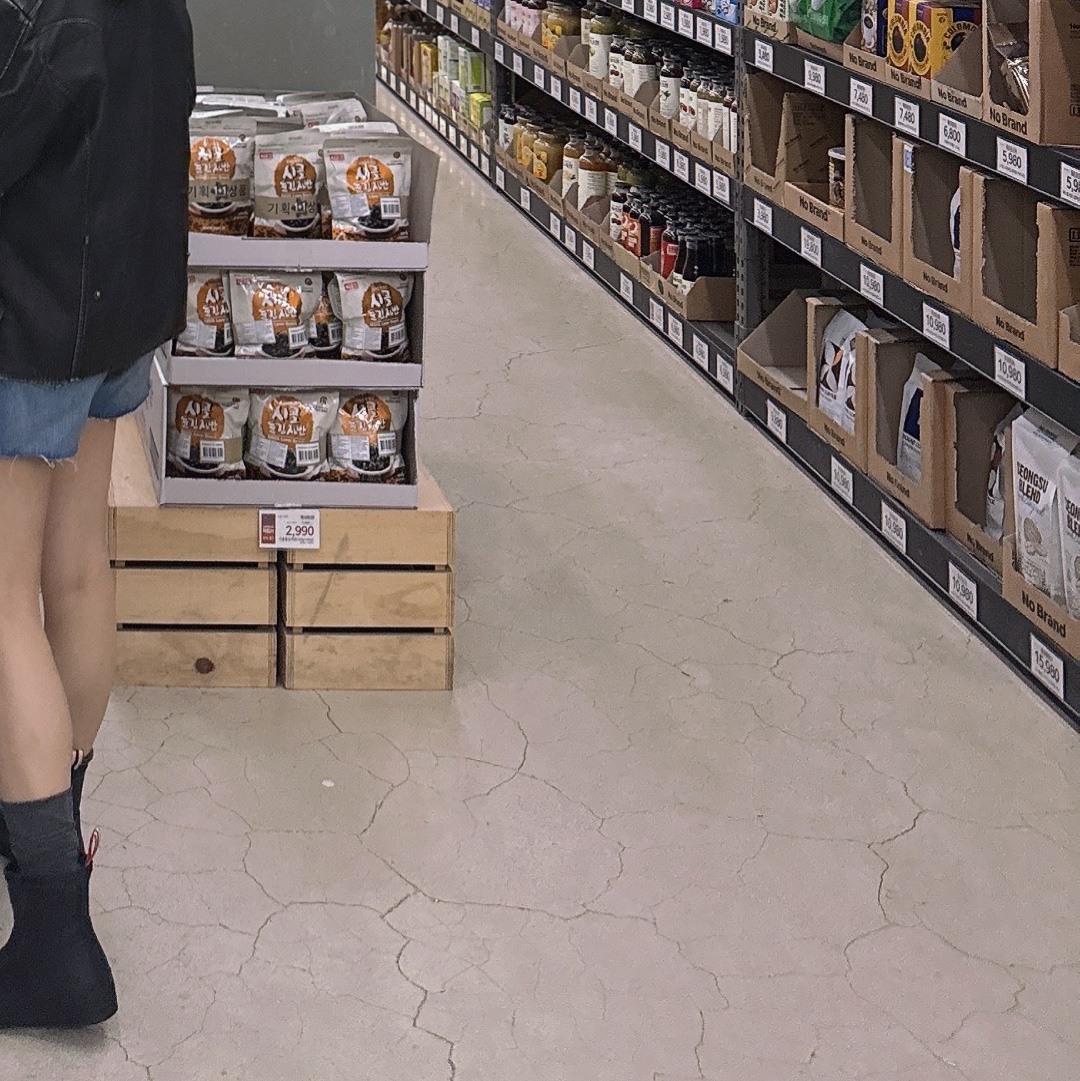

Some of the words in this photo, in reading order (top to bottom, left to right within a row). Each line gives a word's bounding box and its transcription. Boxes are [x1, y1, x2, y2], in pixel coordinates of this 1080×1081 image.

[849, 52, 858, 63] No
[858, 56, 877, 72] Brand
[890, 69, 900, 81] No
[900, 72, 921, 90] Brand
[938, 88, 947, 101] No
[947, 91, 968, 108] Brand
[899, 107, 916, 125] 7,480
[989, 107, 1001, 124] No
[1002, 113, 1028, 136] Brand
[943, 125, 962, 144] 6,800
[1002, 150, 1022, 168] 5,980
[282, 163, 306, 180] 시골
[228, 184, 246, 197] 상품
[267, 201, 291, 215] 기획
[799, 195, 808, 211] No
[809, 200, 829, 221] Brand
[369, 291, 393, 309] 시골
[926, 315, 946, 336] 10,980
[995, 316, 1005, 328] No
[1005, 323, 1025, 342] Brand
[997, 359, 1022, 385] 10,980
[184, 400, 212, 419] 시골
[272, 402, 302, 420] 시골
[285, 525, 315, 538] 2,990
[1021, 589, 1036, 614] No
[1036, 603, 1067, 639] Brand
[1034, 649, 1060, 683] 15,980
